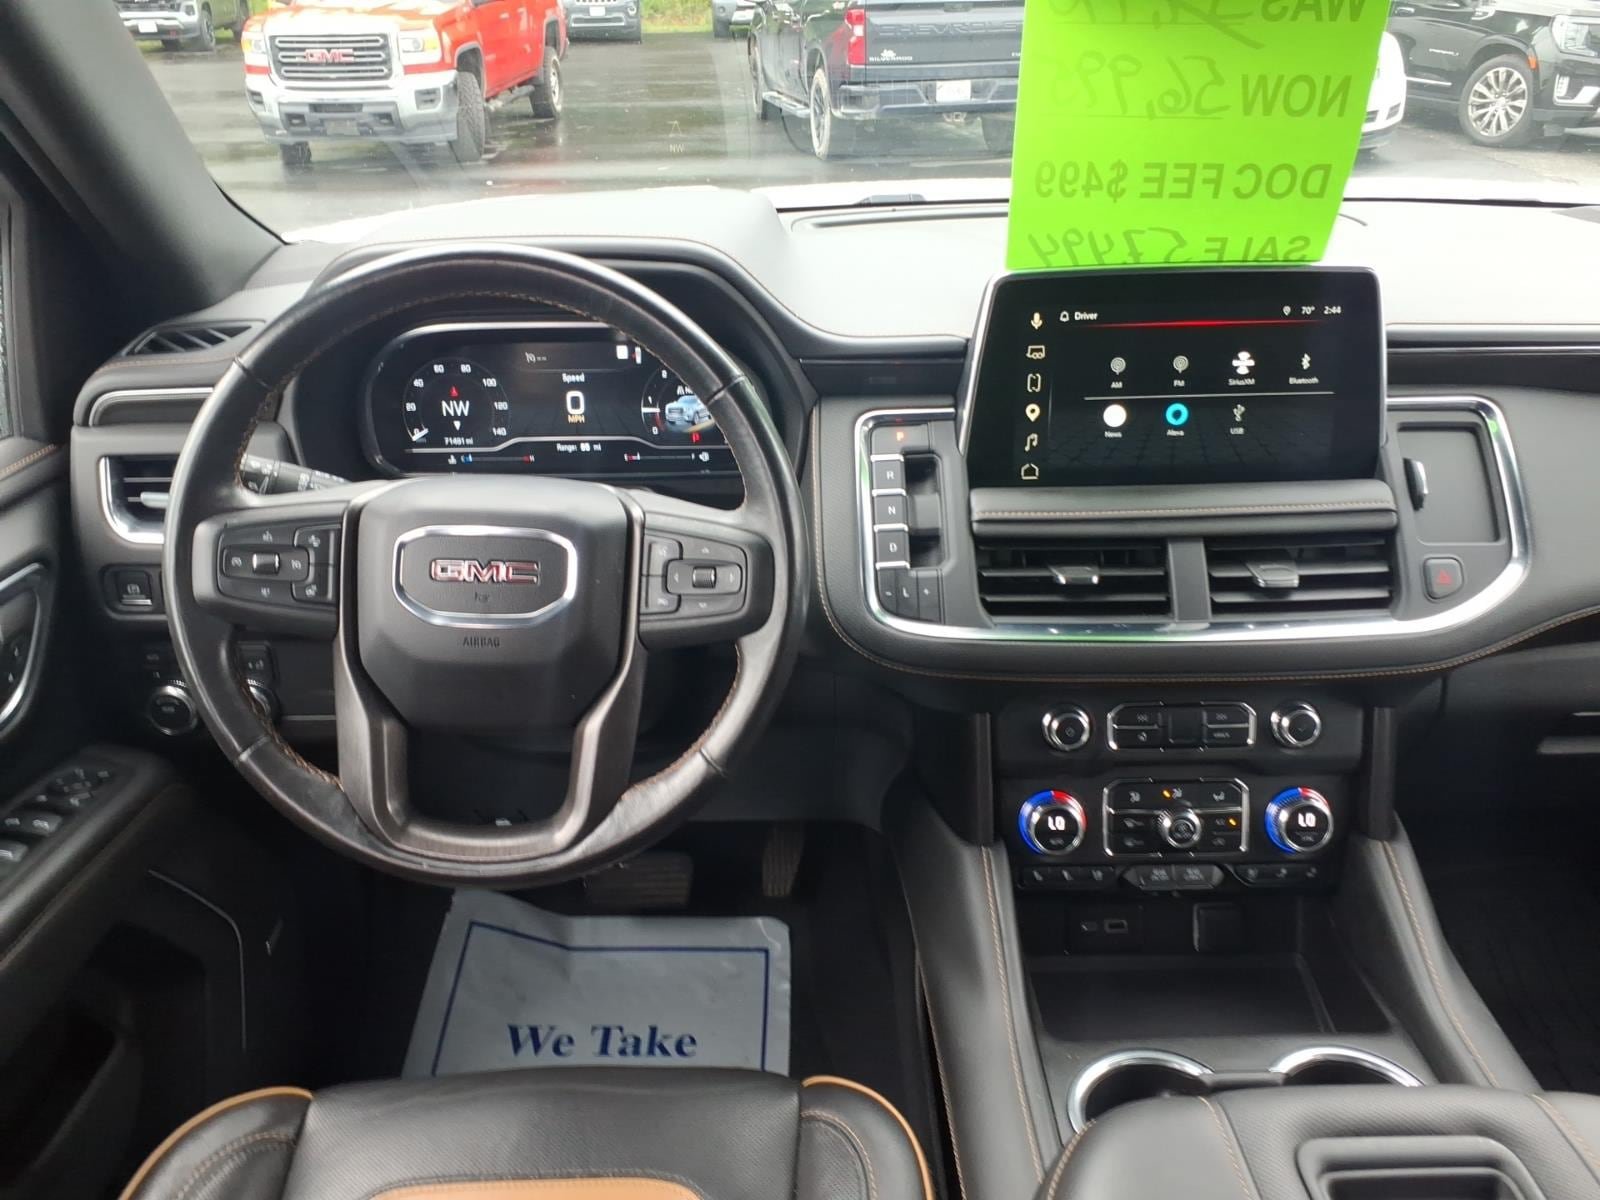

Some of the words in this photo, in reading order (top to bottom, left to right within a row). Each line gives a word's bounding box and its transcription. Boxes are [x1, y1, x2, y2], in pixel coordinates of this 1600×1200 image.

[303, 48, 354, 64] GMC
[1323, 306, 1341, 315] 2:44
[1074, 311, 1098, 321] Driver
[460, 364, 471, 374] 80
[413, 378, 424, 388] 40
[482, 378, 497, 388] 100
[562, 372, 585, 384] Speed
[1173, 379, 1185, 387] FM
[1228, 377, 1255, 386] SiriusXM
[1289, 376, 1319, 385] Bluetooth
[1110, 381, 1123, 389] AM
[494, 401, 508, 411] 120
[565, 390, 585, 415] 0
[441, 400, 470, 417] NW
[567, 414, 585, 423] MPH
[492, 427, 507, 436] 140
[896, 431, 904, 441] P
[1230, 427, 1244, 435] USB
[886, 471, 895, 480] R
[887, 506, 896, 515] N
[889, 543, 898, 552] D
[430, 558, 540, 584] GMC
[463, 636, 501, 649] AIRBAG
[507, 1024, 575, 1058] We
[590, 1024, 697, 1058] Take
